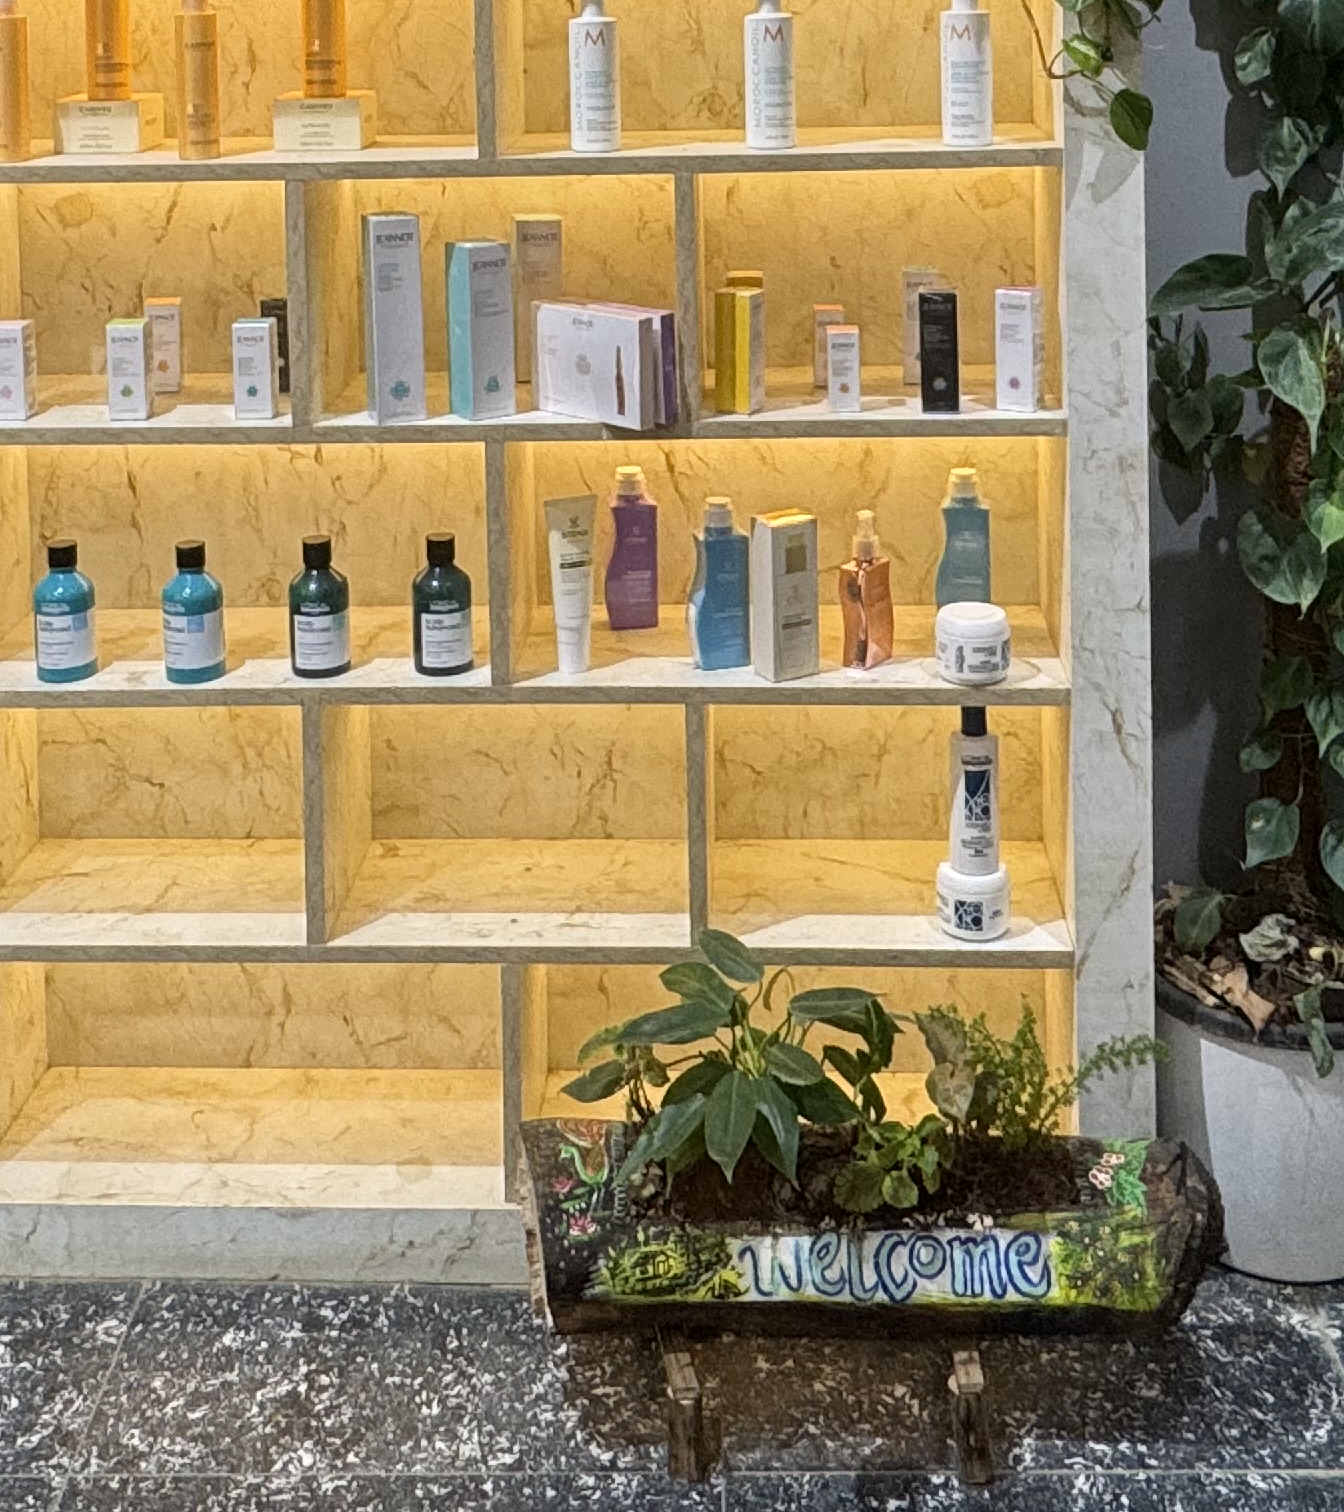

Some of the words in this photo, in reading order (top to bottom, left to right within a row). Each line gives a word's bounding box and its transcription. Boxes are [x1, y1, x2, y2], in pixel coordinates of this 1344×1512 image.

[584, 28, 606, 47] M
[763, 23, 785, 43] M
[950, 23, 972, 41] M
[751, 21, 762, 128] MOROCCANOIL
